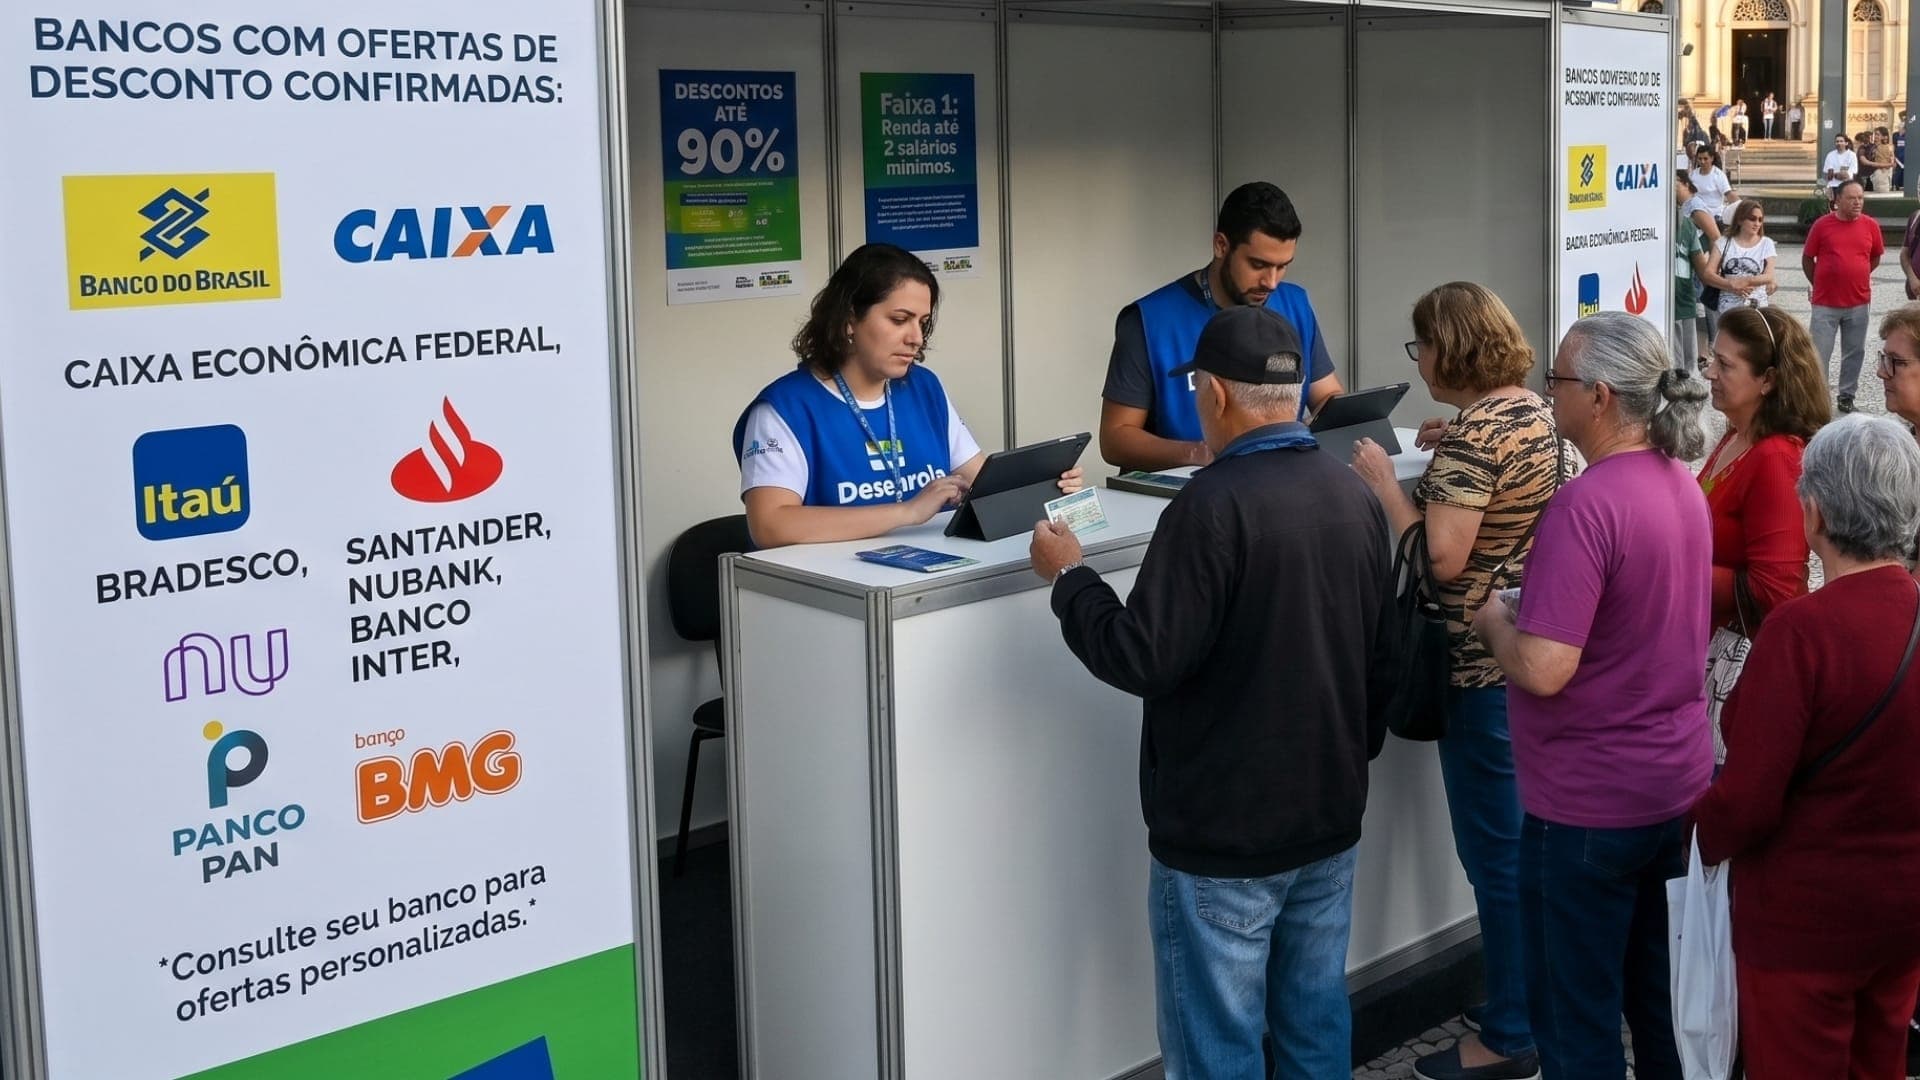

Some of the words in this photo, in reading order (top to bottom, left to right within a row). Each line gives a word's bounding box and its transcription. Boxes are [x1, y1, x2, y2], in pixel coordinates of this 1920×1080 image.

[34, 18, 221, 54] BANCOS
[233, 25, 325, 56] COM
[338, 28, 503, 62] OFERTAS
[514, 34, 557, 62] DE
[30, 65, 272, 100] DESCONTO
[284, 71, 562, 103] CONFIRMADAS:
[675, 83, 784, 100] DESCONTOS
[1565, 68, 1598, 84] BANCOS
[714, 102, 747, 122] ATÉ
[880, 92, 936, 115] Faixa
[941, 93, 958, 115] 1:
[882, 119, 930, 135] Renda
[934, 118, 959, 135] até
[884, 140, 894, 156] 2
[898, 139, 957, 156] salários
[677, 128, 785, 175] 90%
[1615, 163, 1658, 191] CAIXA
[334, 204, 555, 263] CAIXA
[80, 274, 158, 297] BANCO
[163, 273, 192, 292] DO
[195, 270, 270, 291] BRASIL
[65, 353, 182, 389] CAIXA
[192, 335, 407, 380] ECONÔMICA
[416, 326, 561, 361] FEDERAL,
[143, 475, 243, 525] Itaú
[347, 512, 551, 565] SANTANDER,
[97, 549, 307, 604] BRADESCO,
[349, 556, 501, 604] NUBANK,
[351, 599, 471, 643] BANCO
[352, 640, 460, 682] INTER,
[355, 729, 522, 824] BMG
[172, 803, 306, 856] PANCO
[202, 842, 279, 883] PAN
[327, 909, 379, 940] seu
[389, 883, 476, 924] banco
[486, 864, 546, 905] para
[176, 973, 291, 1022] ofertas
